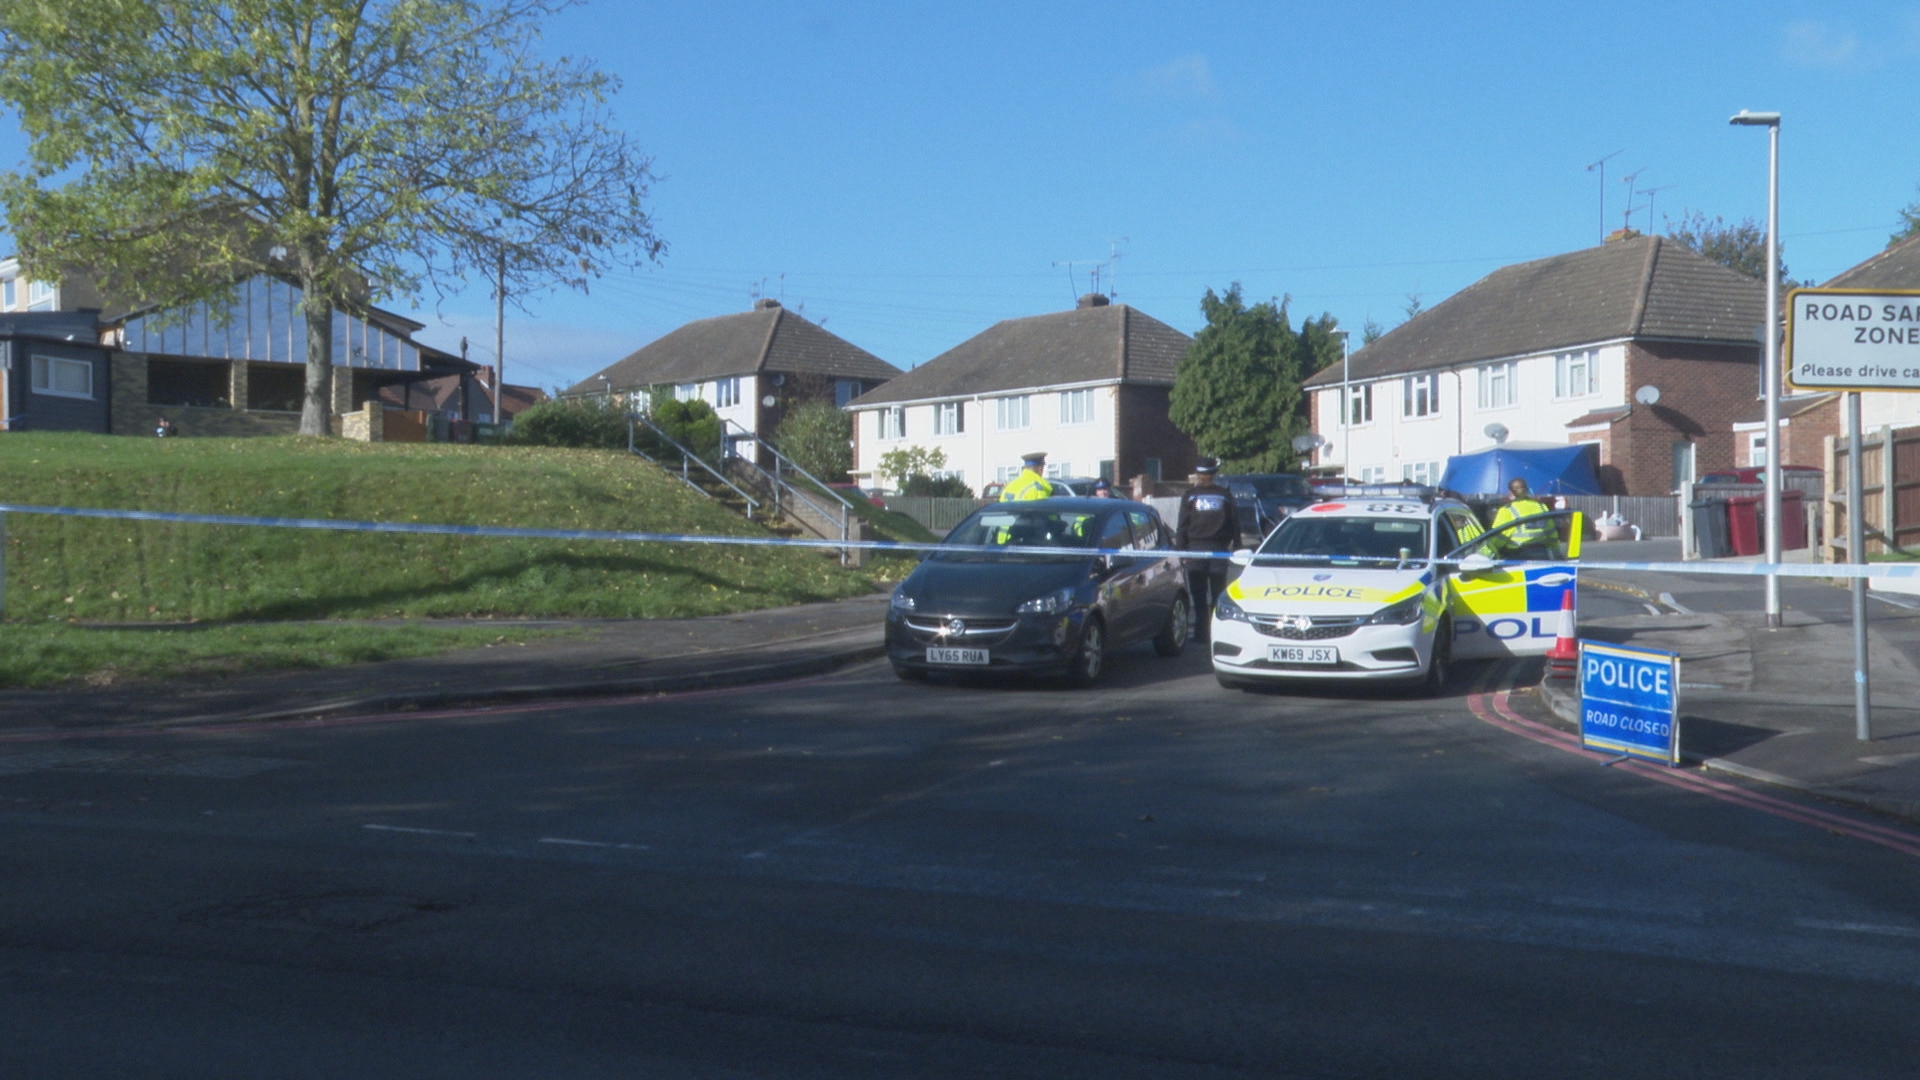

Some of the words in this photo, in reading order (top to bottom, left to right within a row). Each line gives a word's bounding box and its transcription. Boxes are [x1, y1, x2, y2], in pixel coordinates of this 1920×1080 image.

[1806, 303, 1872, 321] ROAD
[1854, 326, 1920, 345] ZONE
[1801, 364, 1852, 376] Please
[1858, 364, 1897, 377] drive
[1263, 586, 1364, 599] POLICE
[1453, 617, 1558, 640] POL
[930, 649, 960, 662] LY65
[962, 650, 985, 662] RUA
[1272, 648, 1304, 661] KW69
[1307, 649, 1331, 661] JSX
[1587, 658, 1669, 695] POLICE
[1586, 709, 1618, 728] ROAD
[1620, 716, 1670, 737] CLOSED
